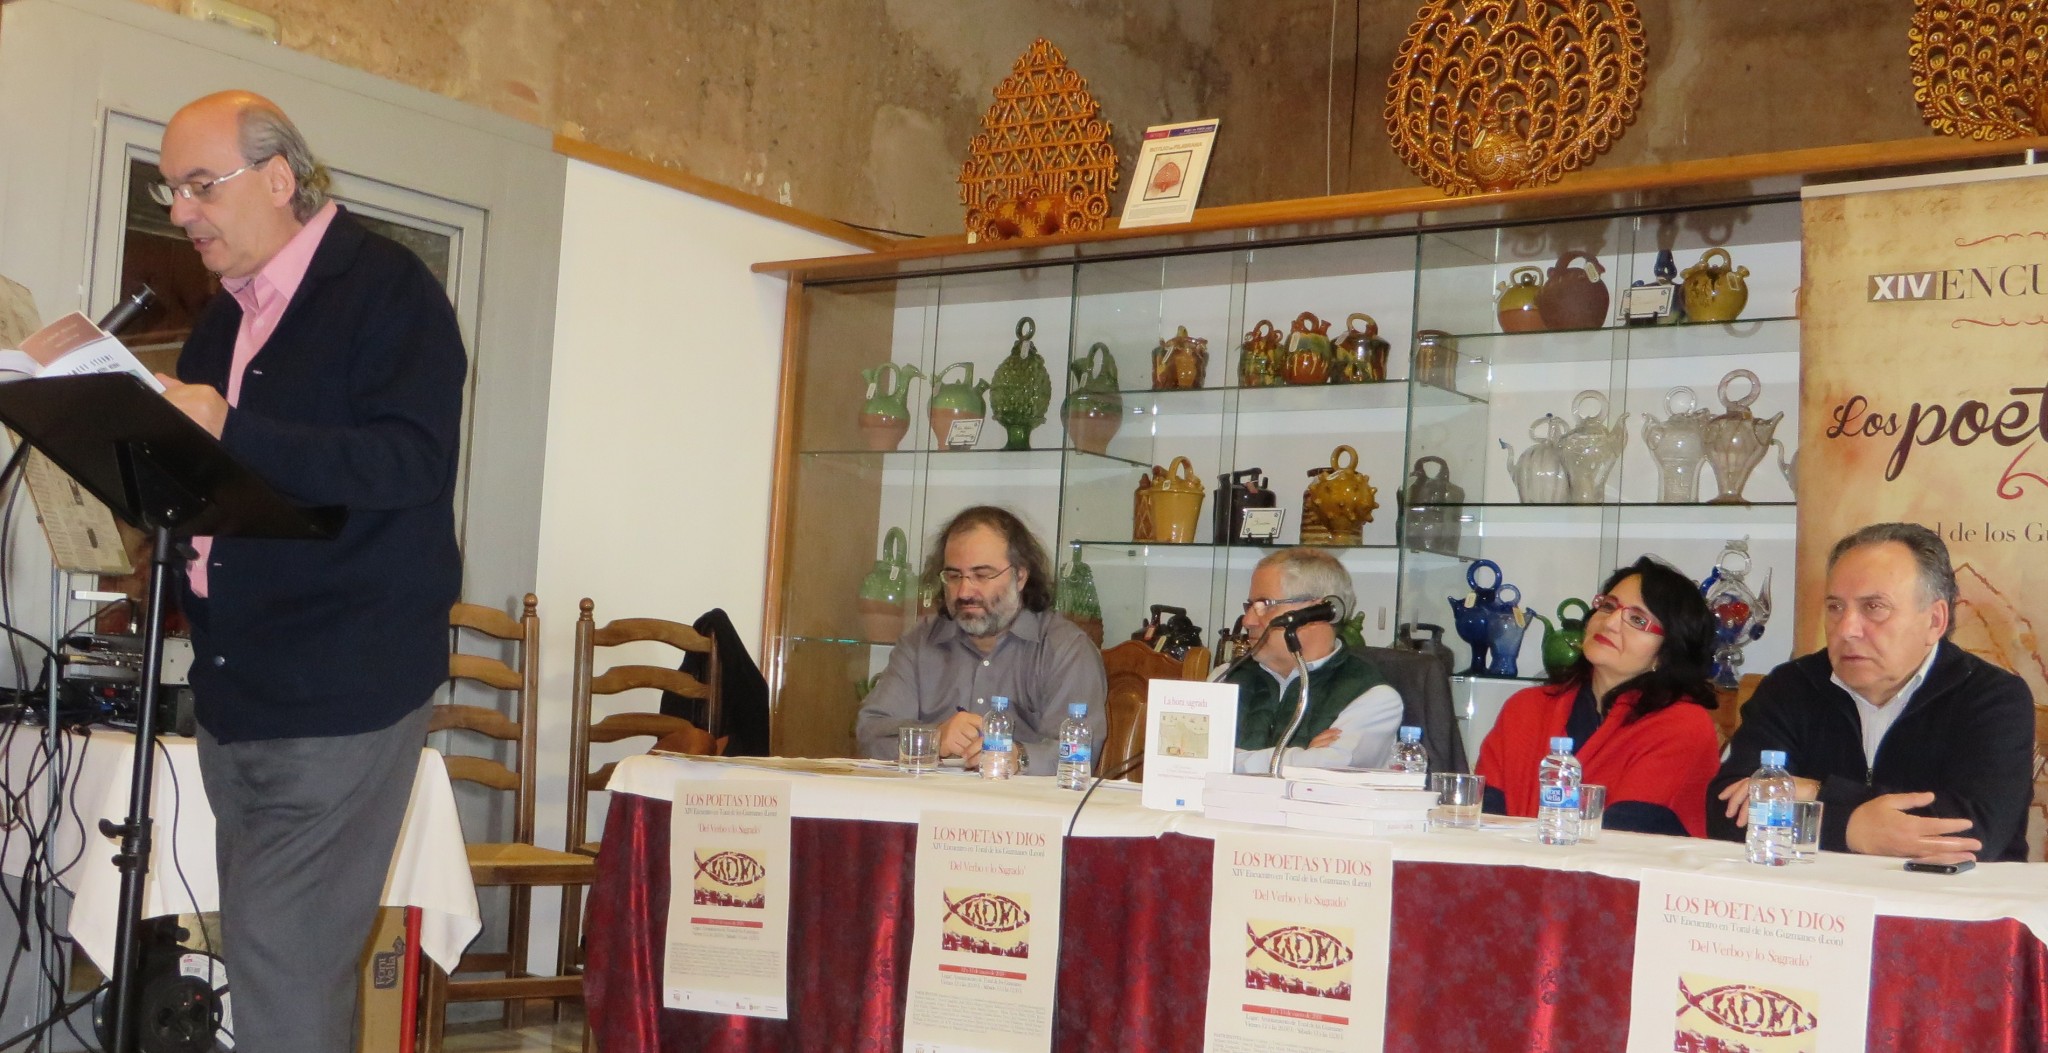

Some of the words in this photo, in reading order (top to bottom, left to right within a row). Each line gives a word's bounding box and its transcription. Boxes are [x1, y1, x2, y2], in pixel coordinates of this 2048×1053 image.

[1873, 274, 1931, 300] XIV
[1826, 395, 1902, 439] Los
[1950, 522, 1976, 542] de
[1985, 522, 2016, 542] los
[686, 793, 703, 806] LOS
[706, 794, 742, 807] POETAS
[754, 795, 778, 807] DIOS
[934, 826, 955, 840] LOS
[958, 828, 1003, 844] POETAS
[1016, 832, 1045, 847] DIOS
[964, 861, 984, 873] Verbo
[1233, 850, 1260, 867] LOS
[1264, 853, 1319, 872] POETAS
[1336, 858, 1372, 876] DIOS
[1232, 868, 1244, 877] XIV
[1246, 870, 1275, 880] Encuentro
[1285, 872, 1300, 882] Toral
[1310, 874, 1318, 883] los
[1319, 876, 1350, 886] Guzmanes
[1271, 890, 1296, 903] Verbo
[1665, 893, 1700, 914] LOS
[1704, 898, 1775, 923] POETAS
[1797, 910, 1845, 933] DIOS
[1663, 913, 1679, 923] XIV
[1680, 917, 1718, 930] Encuentro
[1731, 923, 1751, 934] Toral
[1764, 926, 1774, 937] los
[1776, 929, 1816, 942] Guzmanes
[1713, 941, 1744, 958] Verbo
[386, 956, 395, 984] Vella
